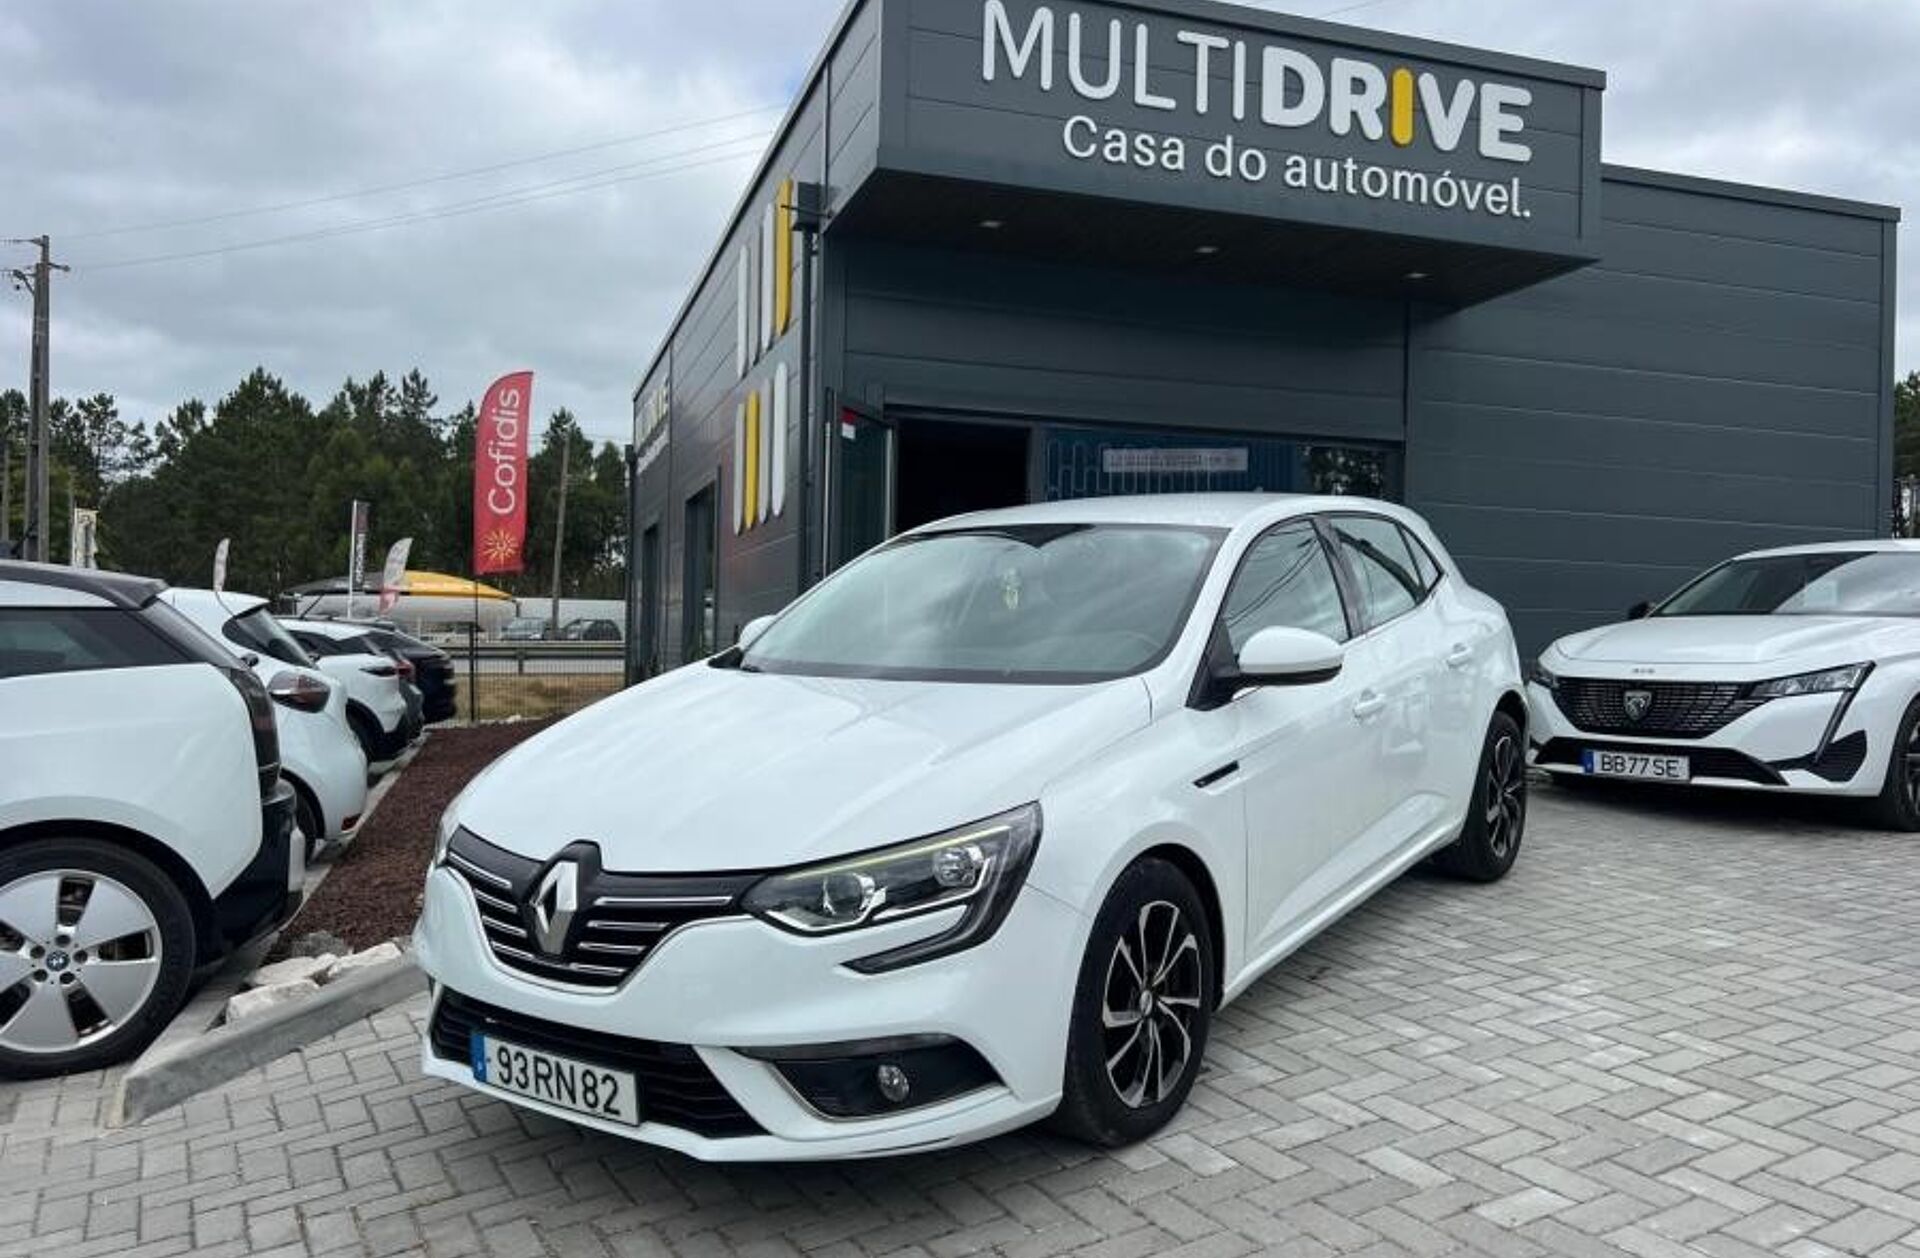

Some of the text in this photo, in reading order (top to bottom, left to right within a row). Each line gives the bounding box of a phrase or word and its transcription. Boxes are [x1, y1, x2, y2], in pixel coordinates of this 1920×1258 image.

[982, 0, 1532, 162] MULTIDRIVE
[1063, 115, 1532, 218] Casa do automóvel.
[488, 388, 520, 515] Cofidis
[497, 1046, 621, 1116] 93RN82
